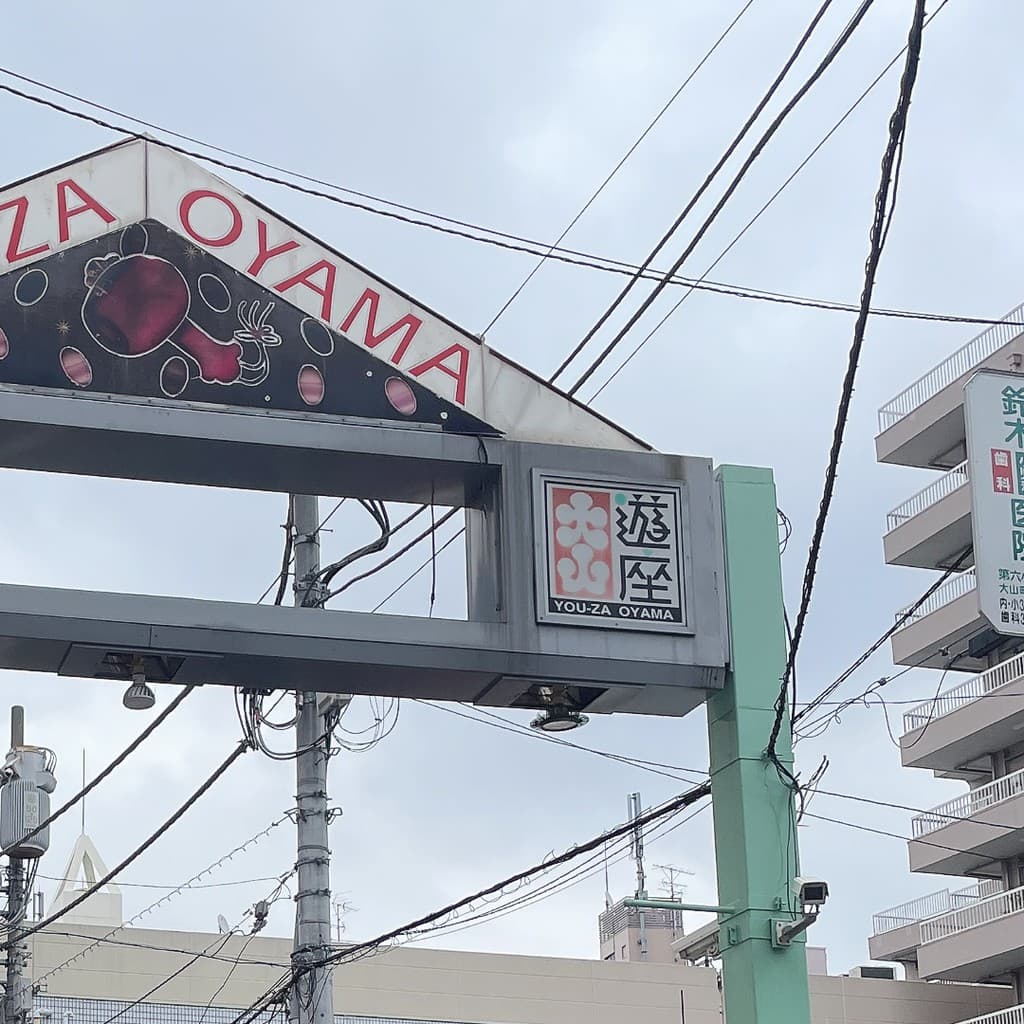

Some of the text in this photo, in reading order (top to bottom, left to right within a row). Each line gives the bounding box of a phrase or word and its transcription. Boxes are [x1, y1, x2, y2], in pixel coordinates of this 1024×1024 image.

[178, 188, 471, 405] OYAMA
[615, 493, 673, 605] 遊座
[554, 599, 674, 621] YOU-ZA OYAMA
